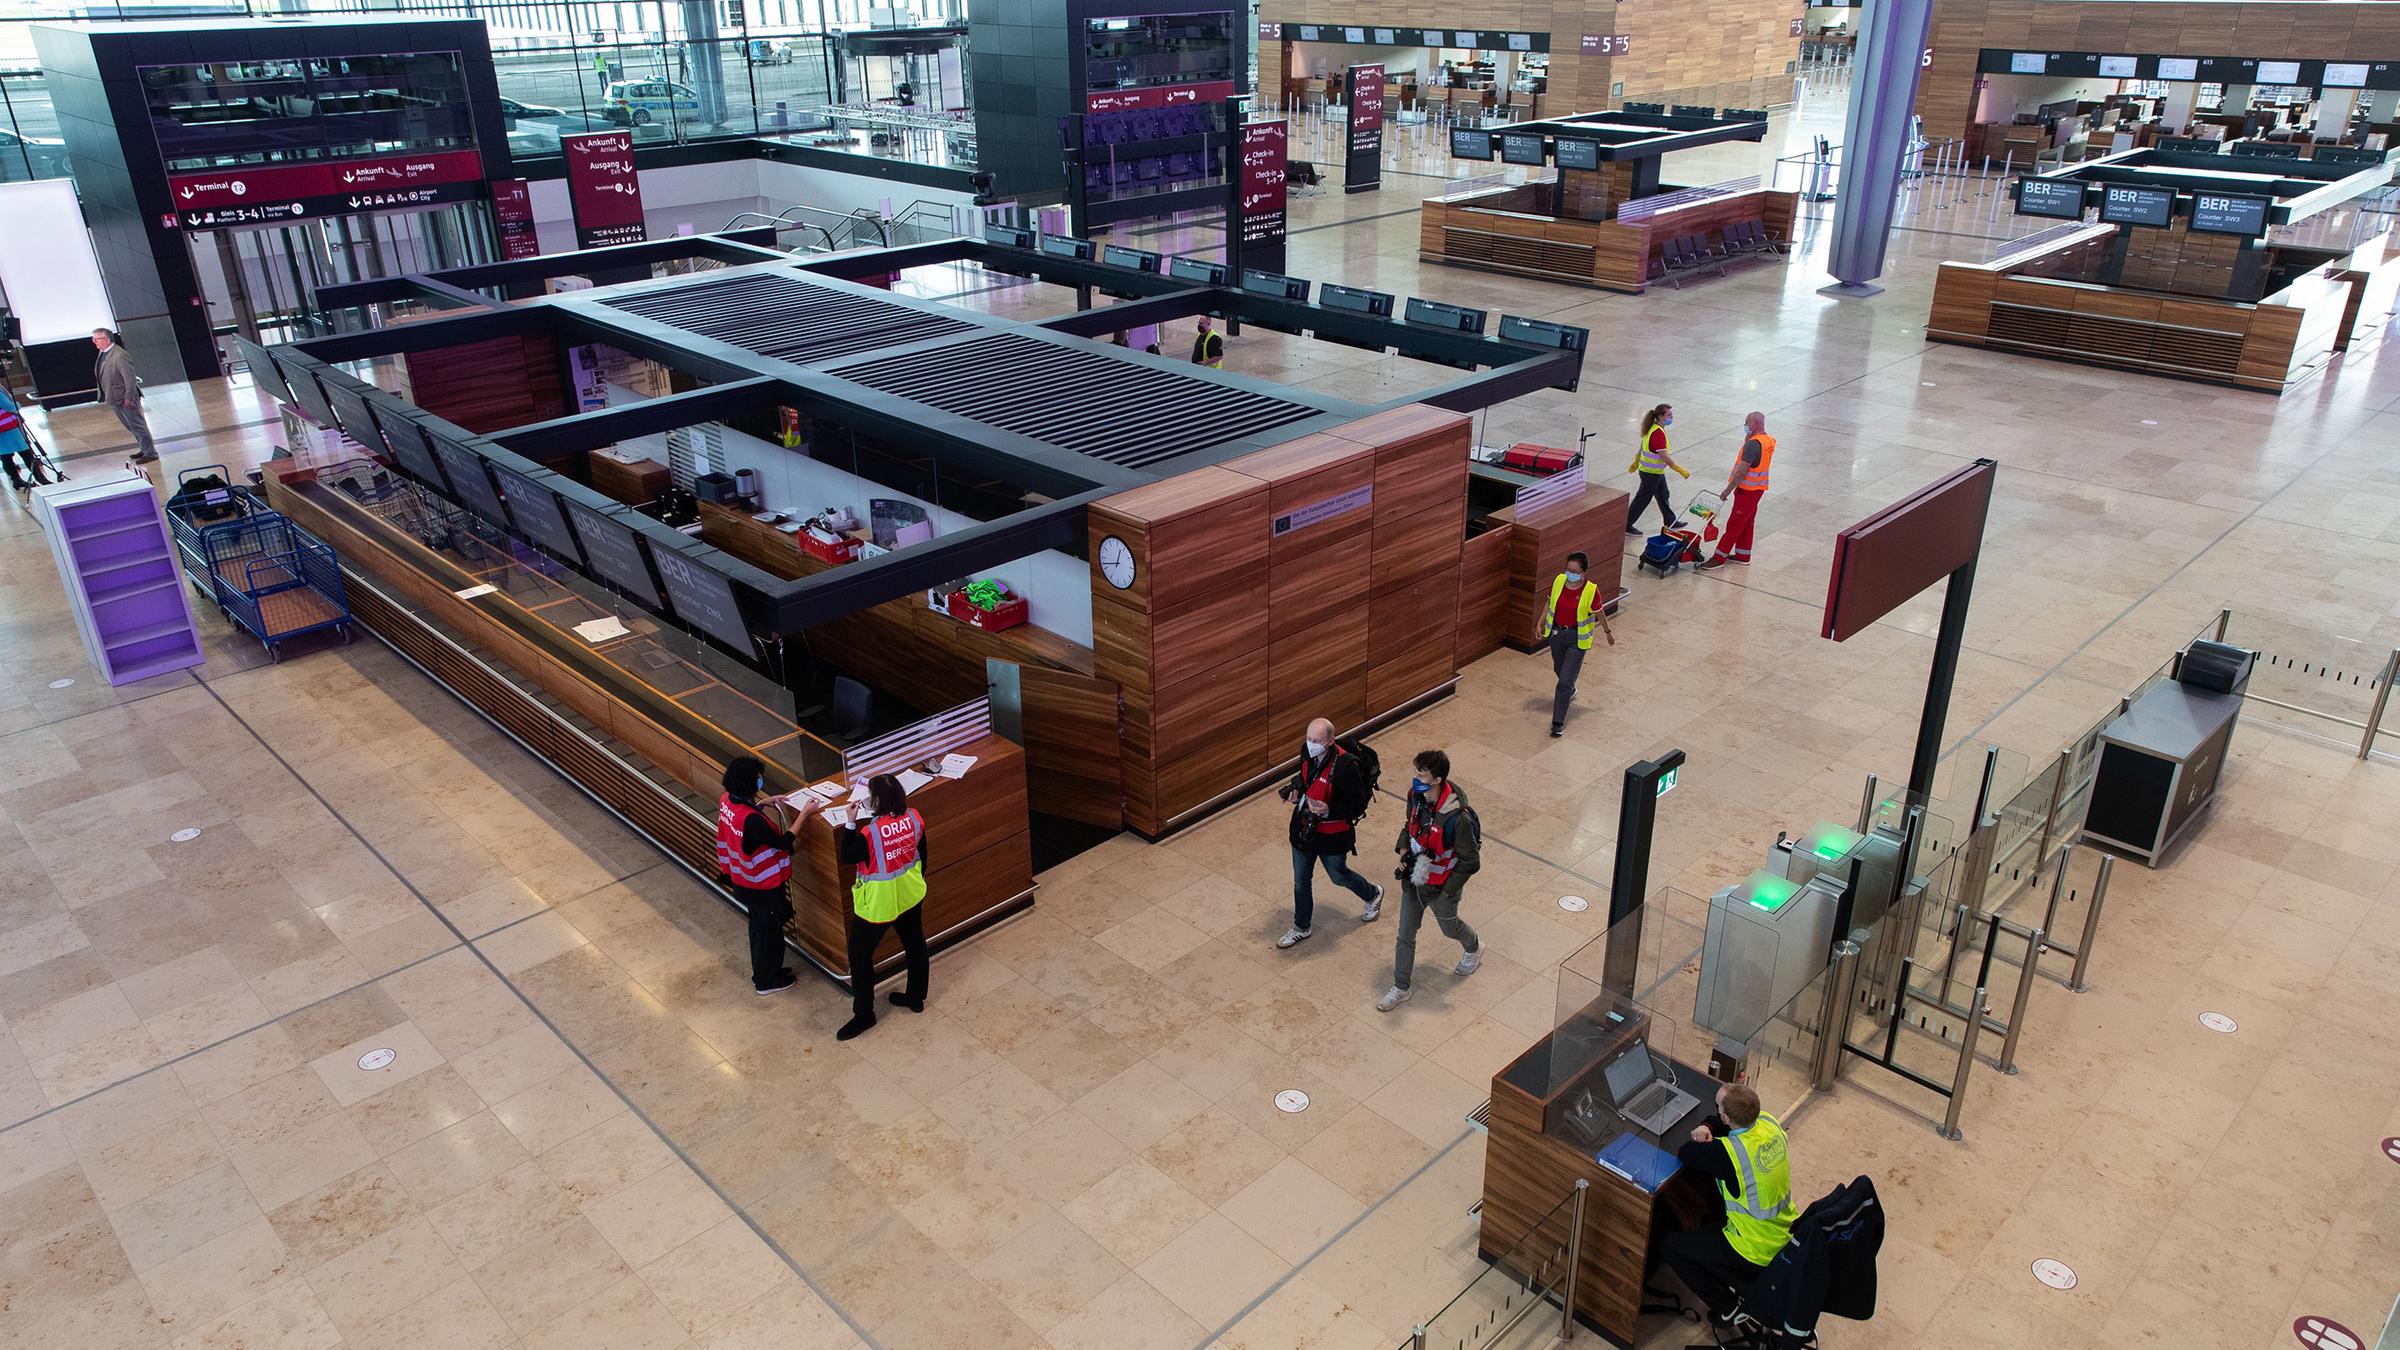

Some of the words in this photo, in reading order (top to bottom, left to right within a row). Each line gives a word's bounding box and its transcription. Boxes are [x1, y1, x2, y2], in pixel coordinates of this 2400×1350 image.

[1274, 24, 1280, 37] 5
[1602, 36, 1611, 52] 5
[1622, 36, 1629, 52] 5
[1922, 48, 1932, 66] 6
[1252, 126, 1273, 136] Ankunft
[1454, 132, 1471, 141] BER
[587, 137, 617, 147] Ankunft
[1505, 137, 1522, 146] BER
[1558, 141, 1576, 151] BER
[1252, 149, 1274, 158] Check-in
[356, 167, 385, 176] Ankunft
[406, 163, 435, 172] Ausgang
[590, 161, 620, 170] Ausgang
[1255, 170, 1277, 179] Check-in
[194, 182, 229, 192] Terminal
[2025, 181, 2051, 195] BER
[512, 190, 523, 199] T1
[2110, 189, 2137, 203] BER
[2200, 197, 2230, 211] BER
[496, 470, 530, 504] BER
[570, 507, 608, 544] BER
[653, 547, 695, 589] BER
[881, 817, 912, 838] ORAT
[884, 831, 914, 846] Management
[886, 848, 902, 860] BER
